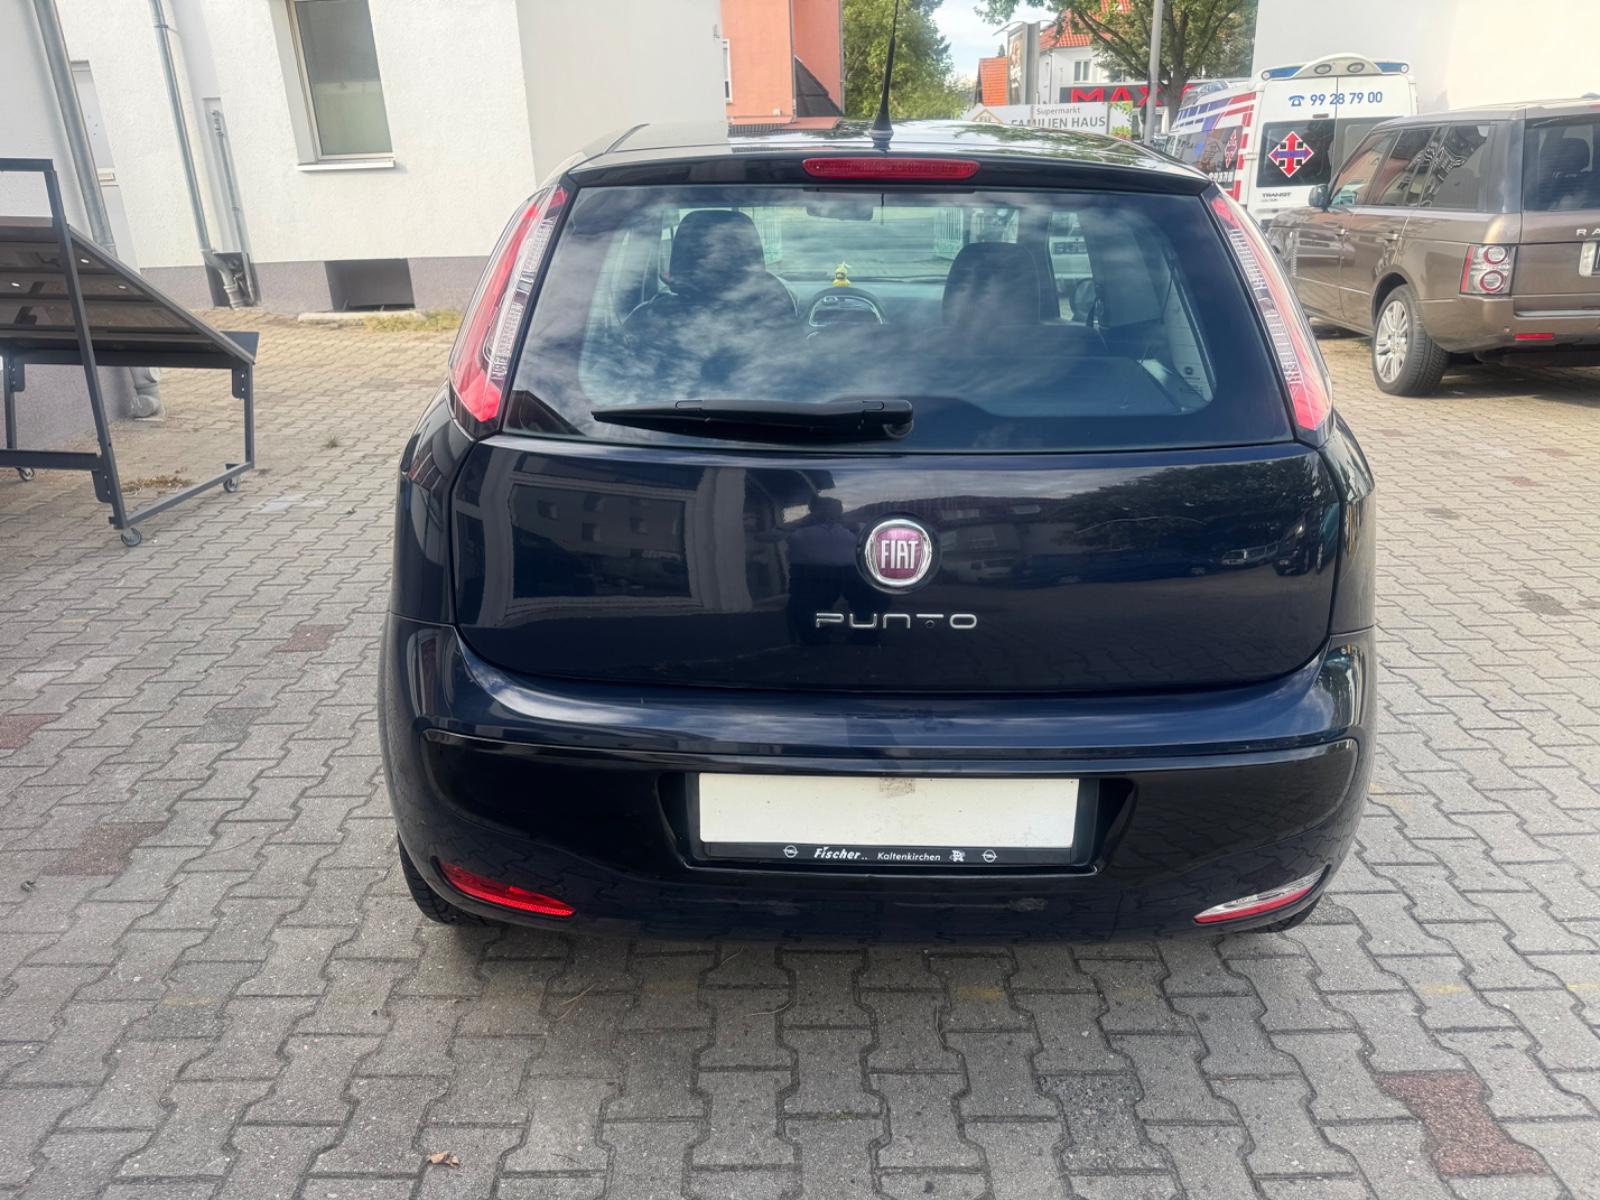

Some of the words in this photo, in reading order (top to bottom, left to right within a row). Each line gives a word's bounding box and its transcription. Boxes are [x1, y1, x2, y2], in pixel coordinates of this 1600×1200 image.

[1310, 93, 1326, 106] 99
[1329, 93, 1345, 105] 28
[1349, 92, 1364, 104] 79
[1367, 91, 1383, 103] 00
[1036, 106, 1081, 116] Supermarkt
[1071, 116, 1106, 128] HAUS
[881, 539, 919, 569] FIAT
[815, 612, 978, 630] PUNTO
[876, 851, 941, 861] Kaltenkirchen
